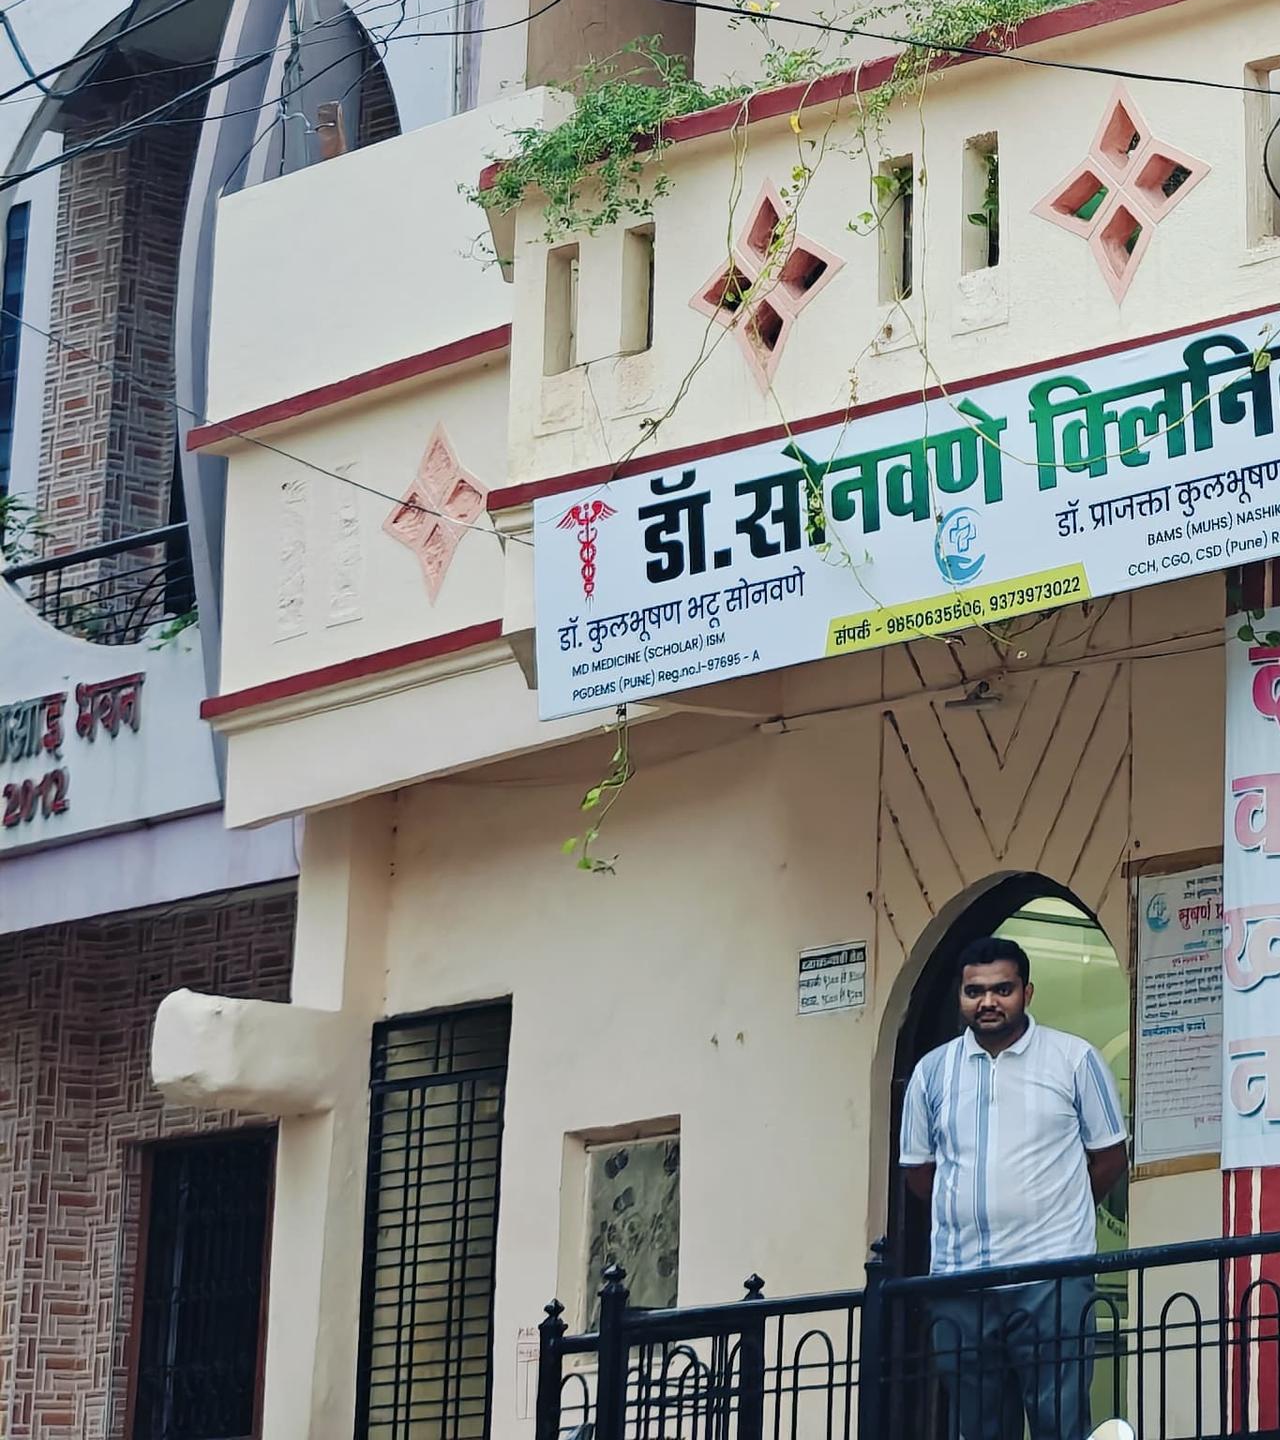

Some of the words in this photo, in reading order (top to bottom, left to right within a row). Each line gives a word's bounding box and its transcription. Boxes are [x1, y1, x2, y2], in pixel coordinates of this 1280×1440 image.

[1055, 498, 1085, 538] डॉ.
[1089, 485, 1171, 530] प्राजक्ता
[1147, 526, 1183, 547] BAMS
[1186, 512, 1233, 541] (MUHS)
[1128, 559, 1159, 577] CCH,
[1161, 550, 1193, 570] CGO,
[1195, 544, 1222, 561] CSD
[1225, 530, 1268, 557] (Pune)
[558, 616, 583, 652] डॉ.
[587, 599, 683, 653] कुलभूषण
[724, 565, 806, 612] सोनवणे
[833, 619, 872, 646] संपर्क
[990, 576, 1081, 612] 9373973022
[571, 662, 590, 677] MD
[591, 650, 641, 673] MEDICINE
[643, 634, 704, 663] (SCHOLAR)
[706, 632, 727, 647] ISM
[572, 681, 616, 701] PGDEMS
[618, 669, 656, 694] (PUNE)
